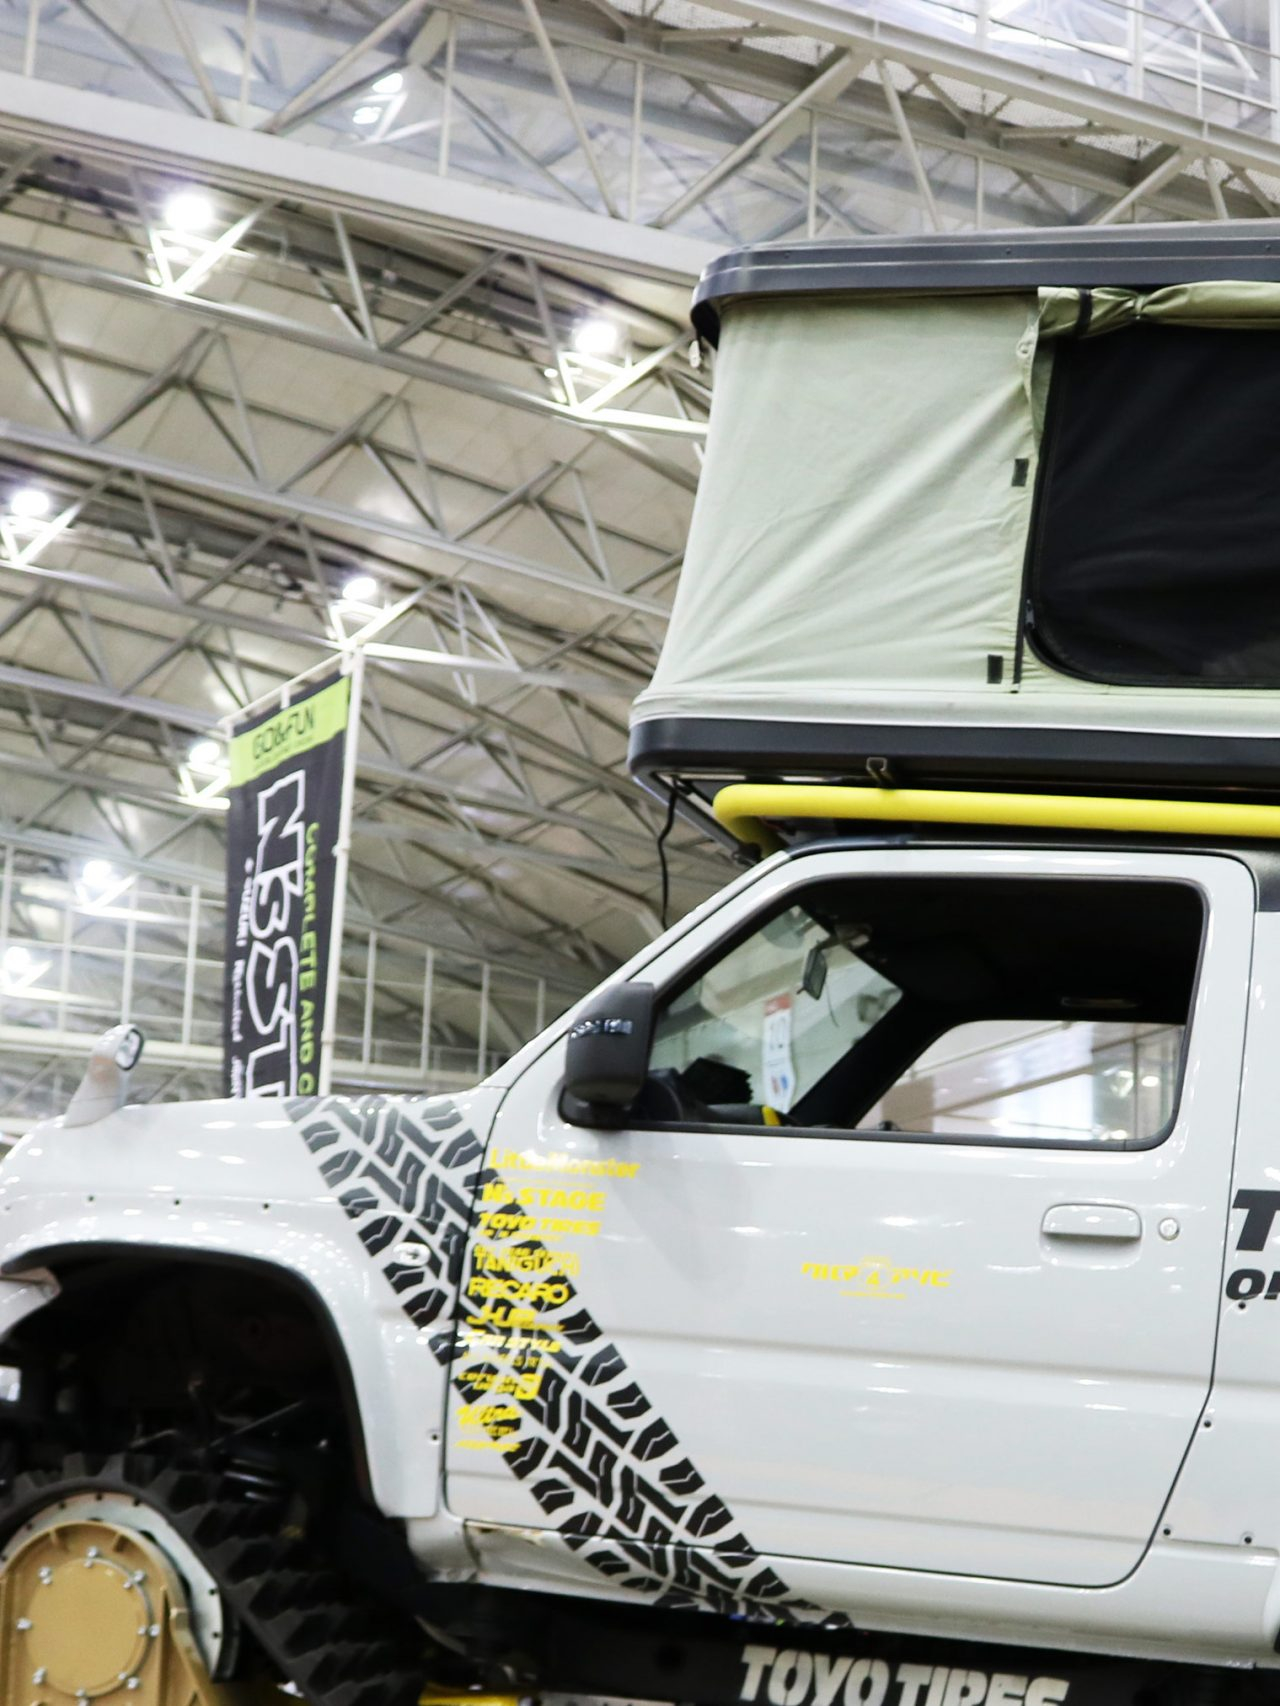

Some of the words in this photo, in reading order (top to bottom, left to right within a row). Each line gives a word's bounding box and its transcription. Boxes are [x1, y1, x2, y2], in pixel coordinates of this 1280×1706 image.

[300, 822, 319, 991] COMPLETE
[300, 999, 315, 1065] AND
[517, 1187, 608, 1212] STAGE
[467, 1276, 570, 1305] RECARO
[740, 1645, 890, 1706] TOYO
